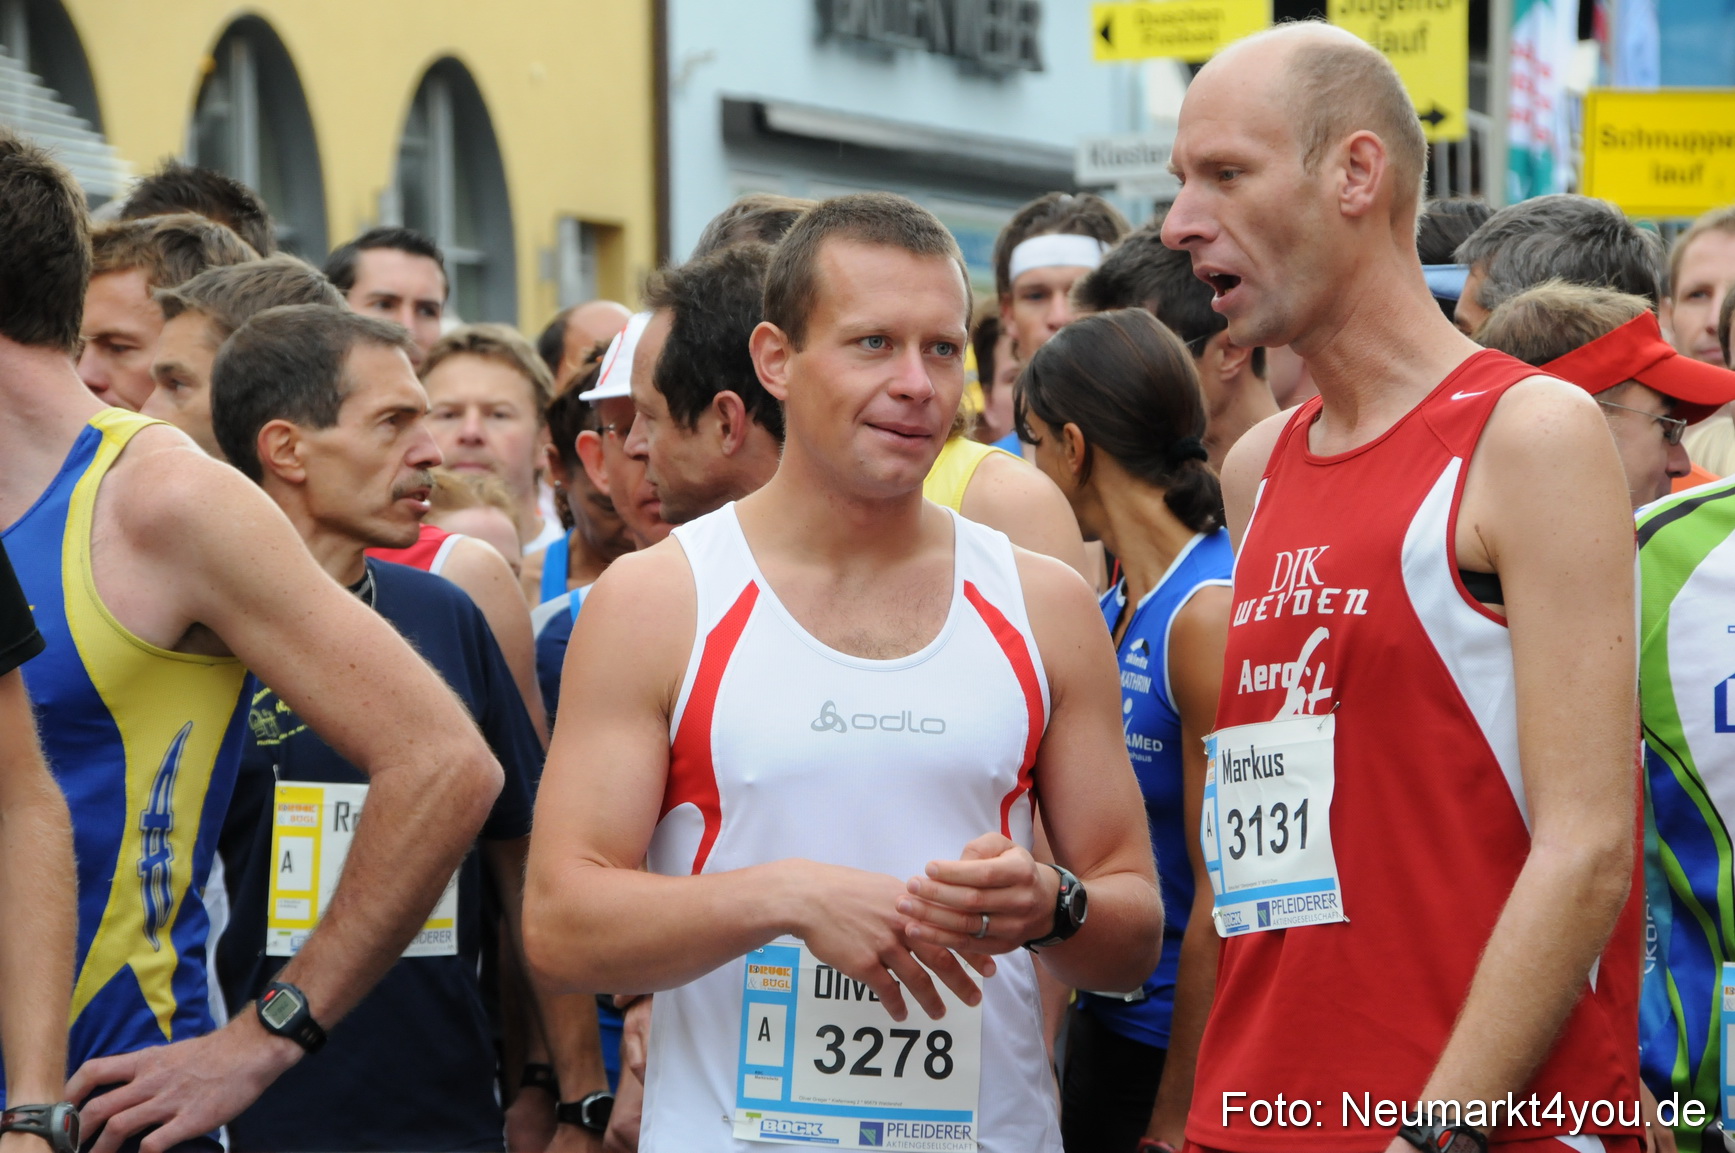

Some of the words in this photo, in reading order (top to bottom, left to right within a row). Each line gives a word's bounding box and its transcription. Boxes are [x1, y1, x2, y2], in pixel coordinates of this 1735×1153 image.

[1372, 21, 1429, 53] lauf
[1650, 159, 1705, 185] lauf
[1268, 545, 1330, 603] DJK
[1121, 669, 1151, 694] KATHRIN
[852, 710, 946, 735] odlo
[1222, 745, 1284, 785] Markus
[1206, 811, 1213, 838] A
[1227, 798, 1309, 861] 3131
[280, 851, 293, 873] A
[1271, 893, 1338, 916] PFLEIDERER
[1273, 911, 1340, 927] AKTIENGESELLSCHAFT
[763, 978, 791, 989] BÜGL
[757, 1016, 771, 1042] A
[813, 1024, 954, 1080] 3278
[760, 1118, 823, 1136] BOCK
[887, 1122, 972, 1140] PFLEIDERER
[886, 1140, 973, 1151] AKTIENGESELLSCHAFT
